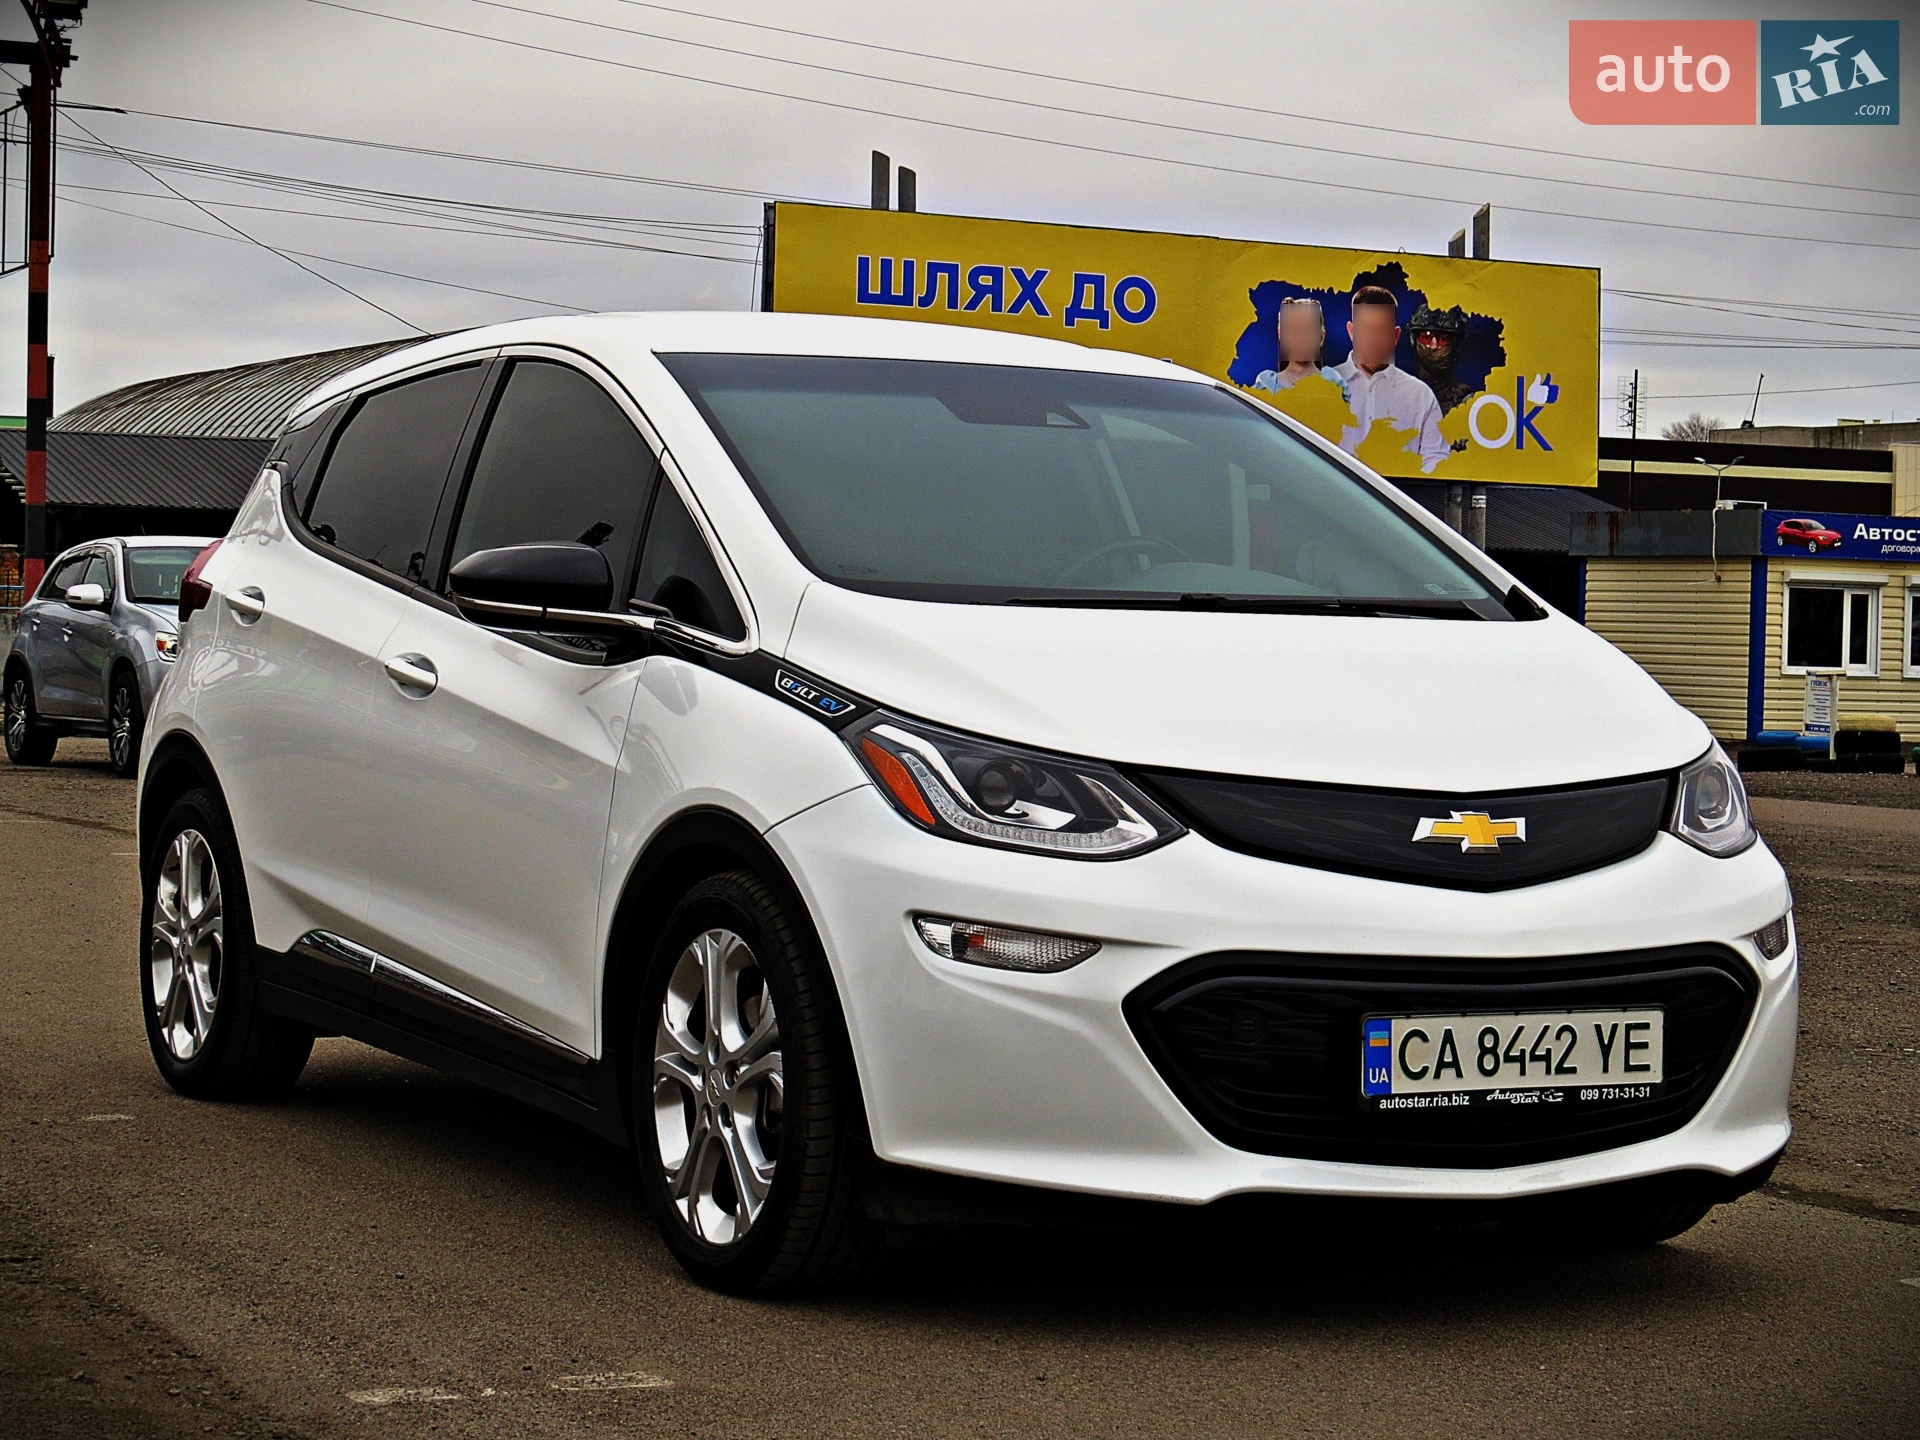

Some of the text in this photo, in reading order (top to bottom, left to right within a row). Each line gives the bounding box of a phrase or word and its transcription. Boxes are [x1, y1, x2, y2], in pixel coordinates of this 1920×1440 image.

[856, 255, 1158, 330] ШЛЯХ ДО
[818, 697, 844, 711] EV
[1398, 1021, 1651, 1081] CA 8442 YE
[1369, 1068, 1389, 1084] UA
[1379, 1093, 1470, 1110] autostar.ria.biz
[1580, 1086, 1651, 1101] 099 731-31-31
